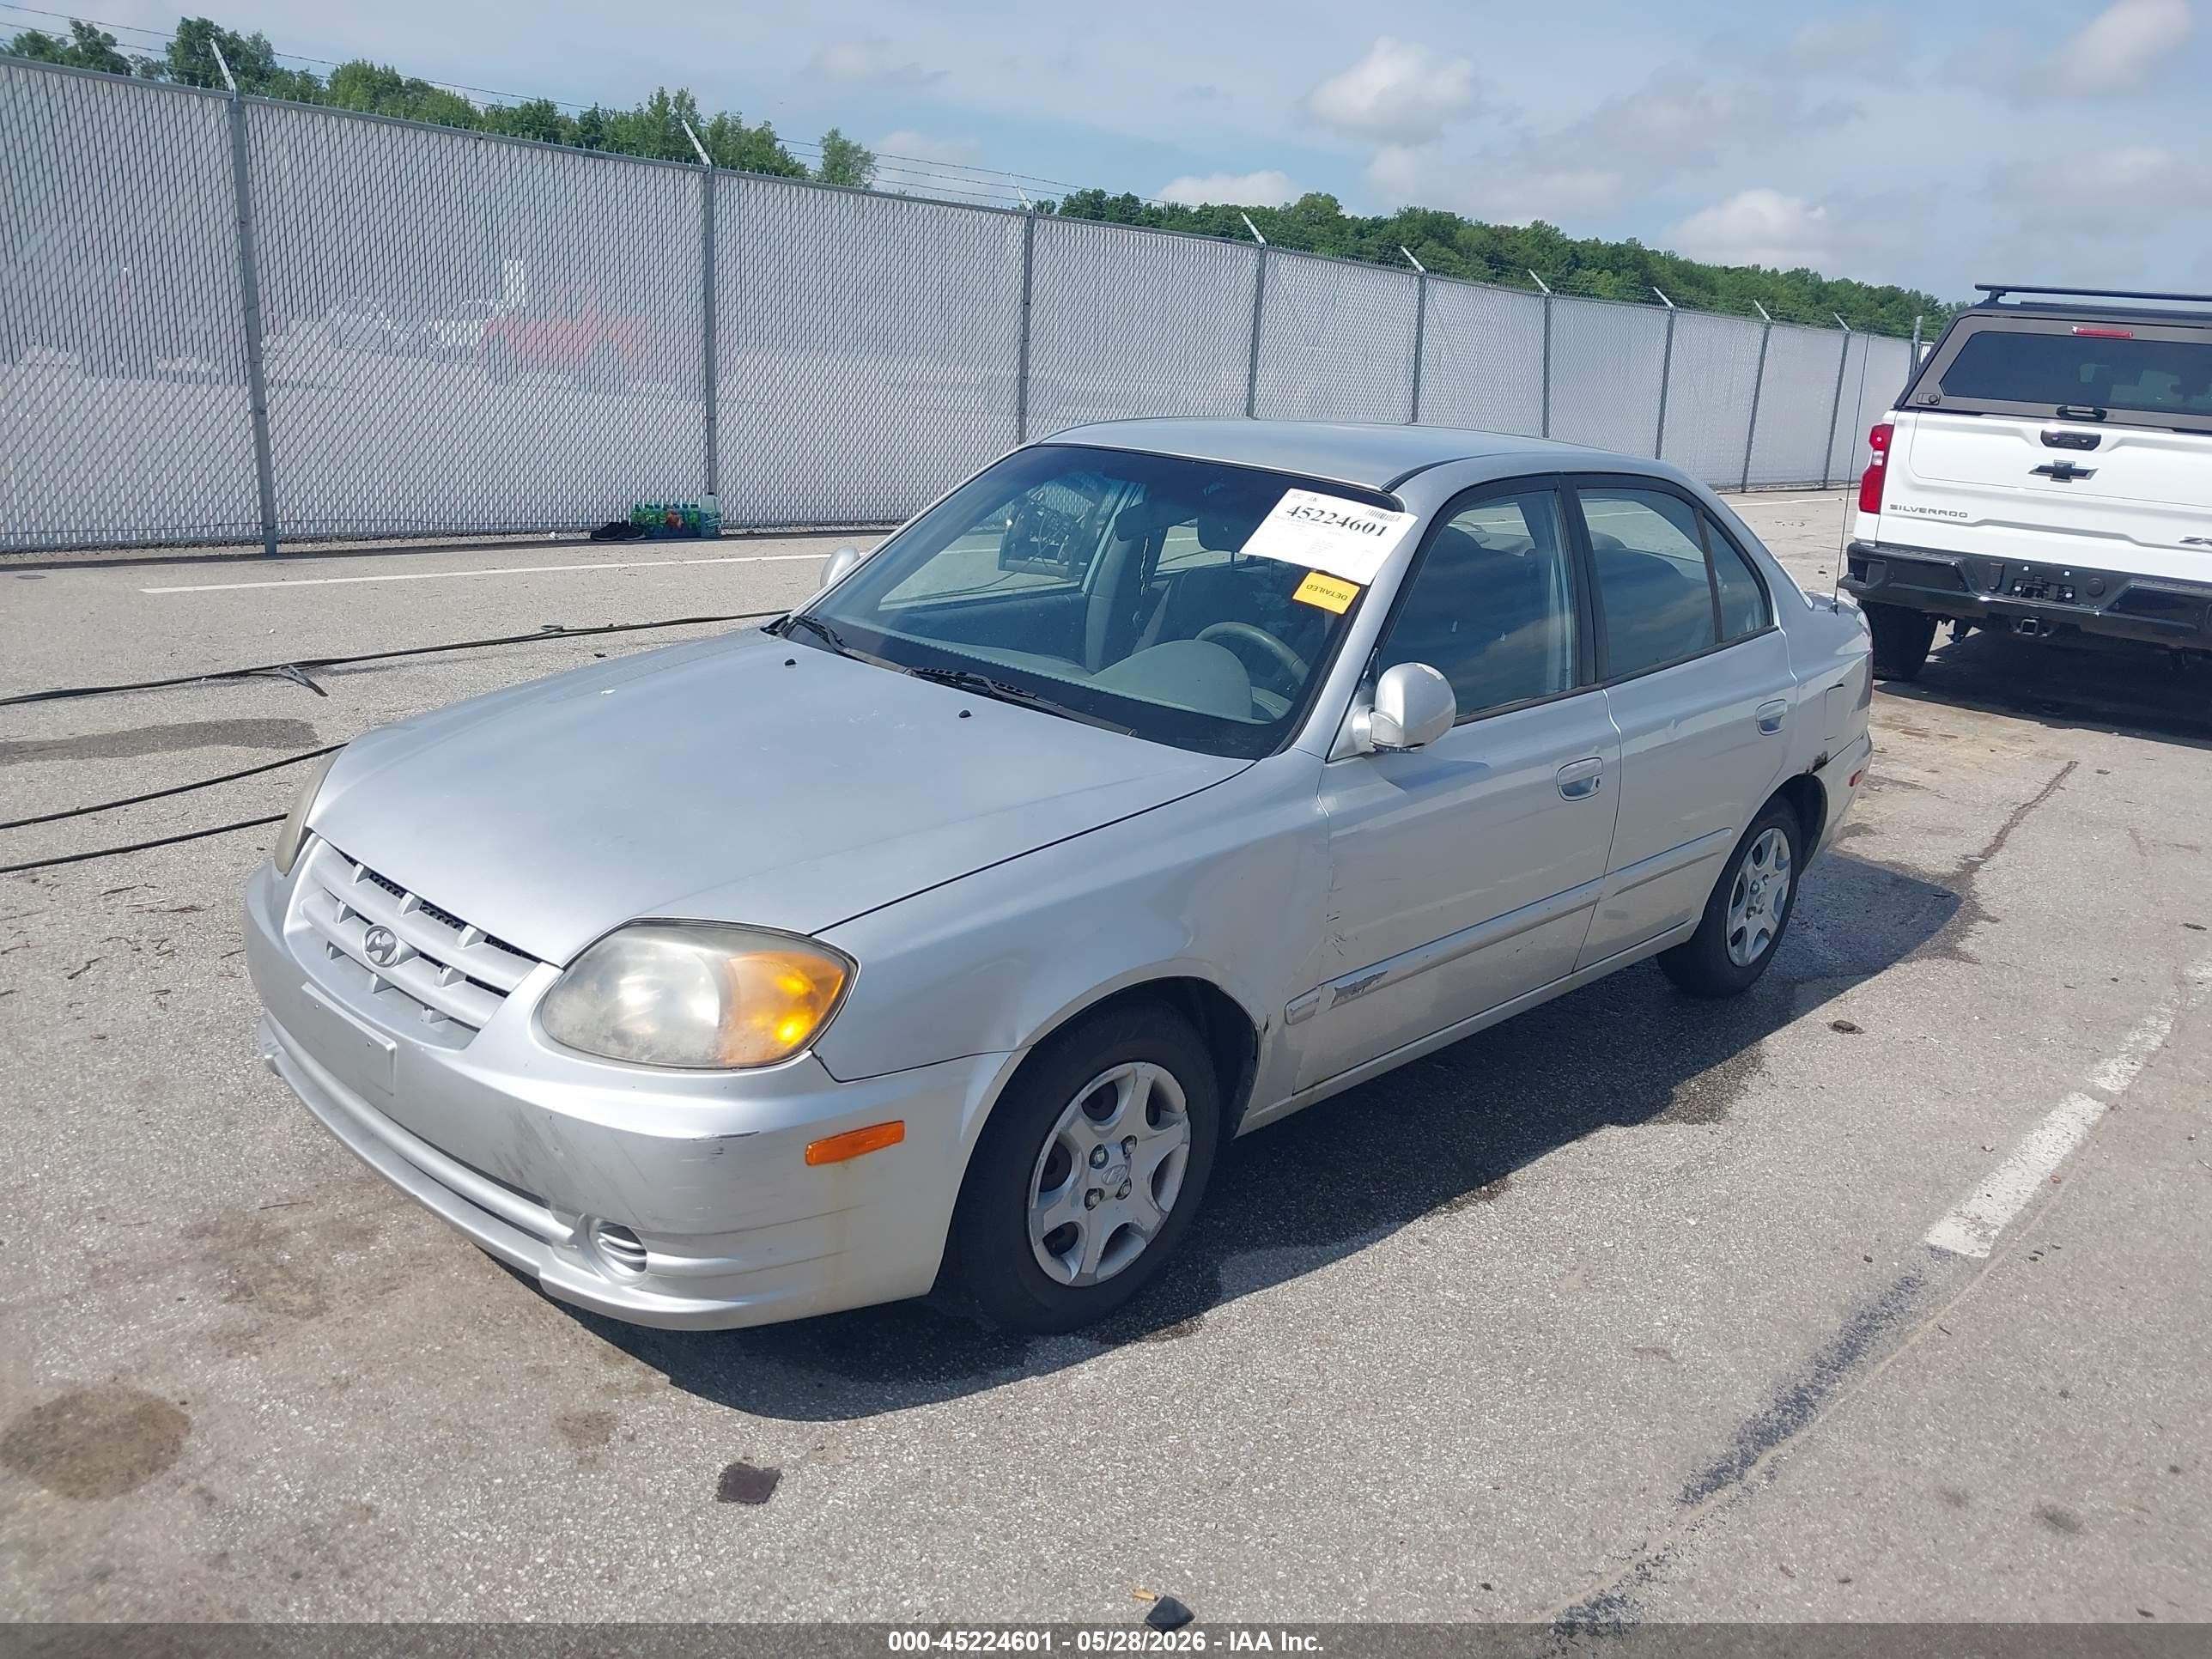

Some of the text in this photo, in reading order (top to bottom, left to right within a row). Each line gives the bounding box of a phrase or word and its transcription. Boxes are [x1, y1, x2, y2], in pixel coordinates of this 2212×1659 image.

[1889, 504, 1968, 519] SILVERADO
[1286, 505, 1388, 537] 45224601
[1306, 584, 1348, 601] DETAILED
